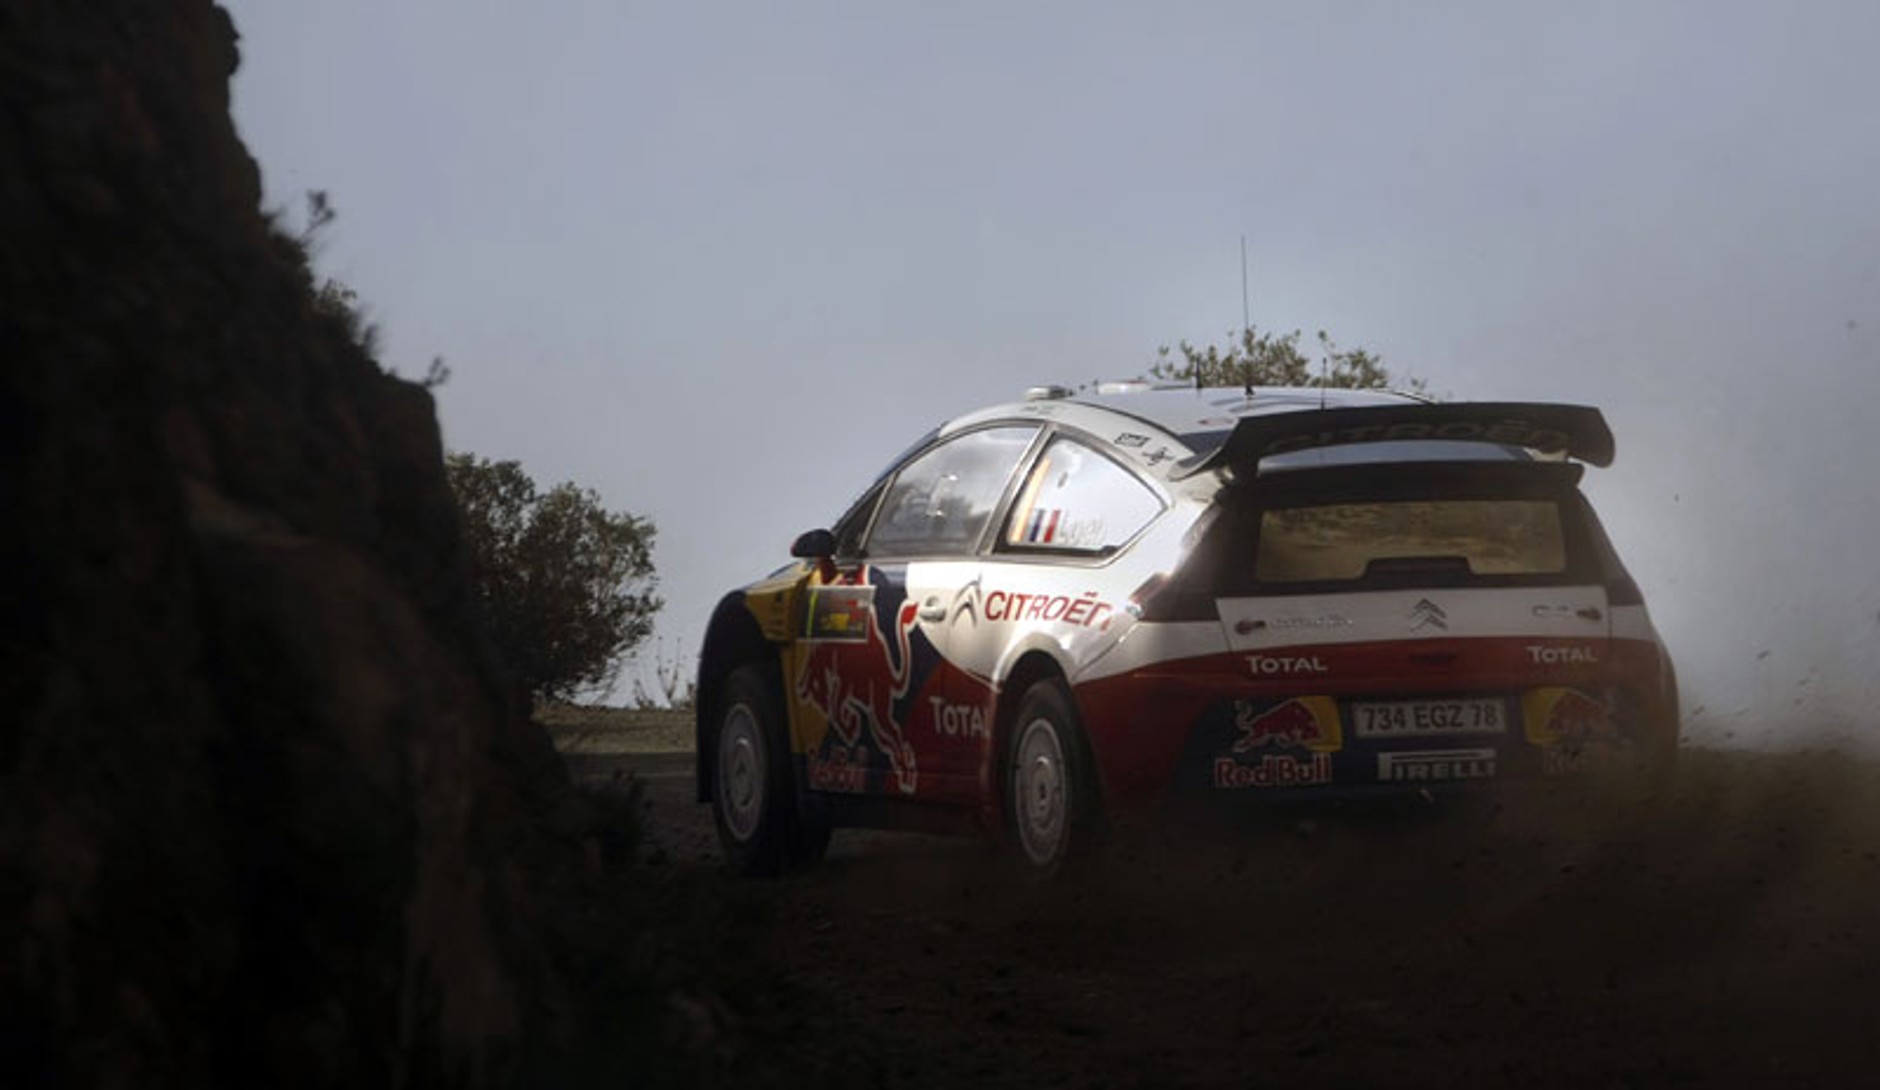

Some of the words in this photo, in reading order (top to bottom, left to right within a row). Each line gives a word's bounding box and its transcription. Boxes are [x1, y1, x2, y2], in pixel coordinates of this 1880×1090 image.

[1245, 654, 1328, 675] TOTAL
[1525, 645, 1599, 664] TOTAL
[1364, 707, 1407, 731] 734
[1413, 705, 1463, 729] EGZ
[1470, 703, 1498, 727] 78
[1215, 754, 1275, 788] Red
[1276, 752, 1332, 786] Bull
[1377, 749, 1497, 781] PIRELLI
